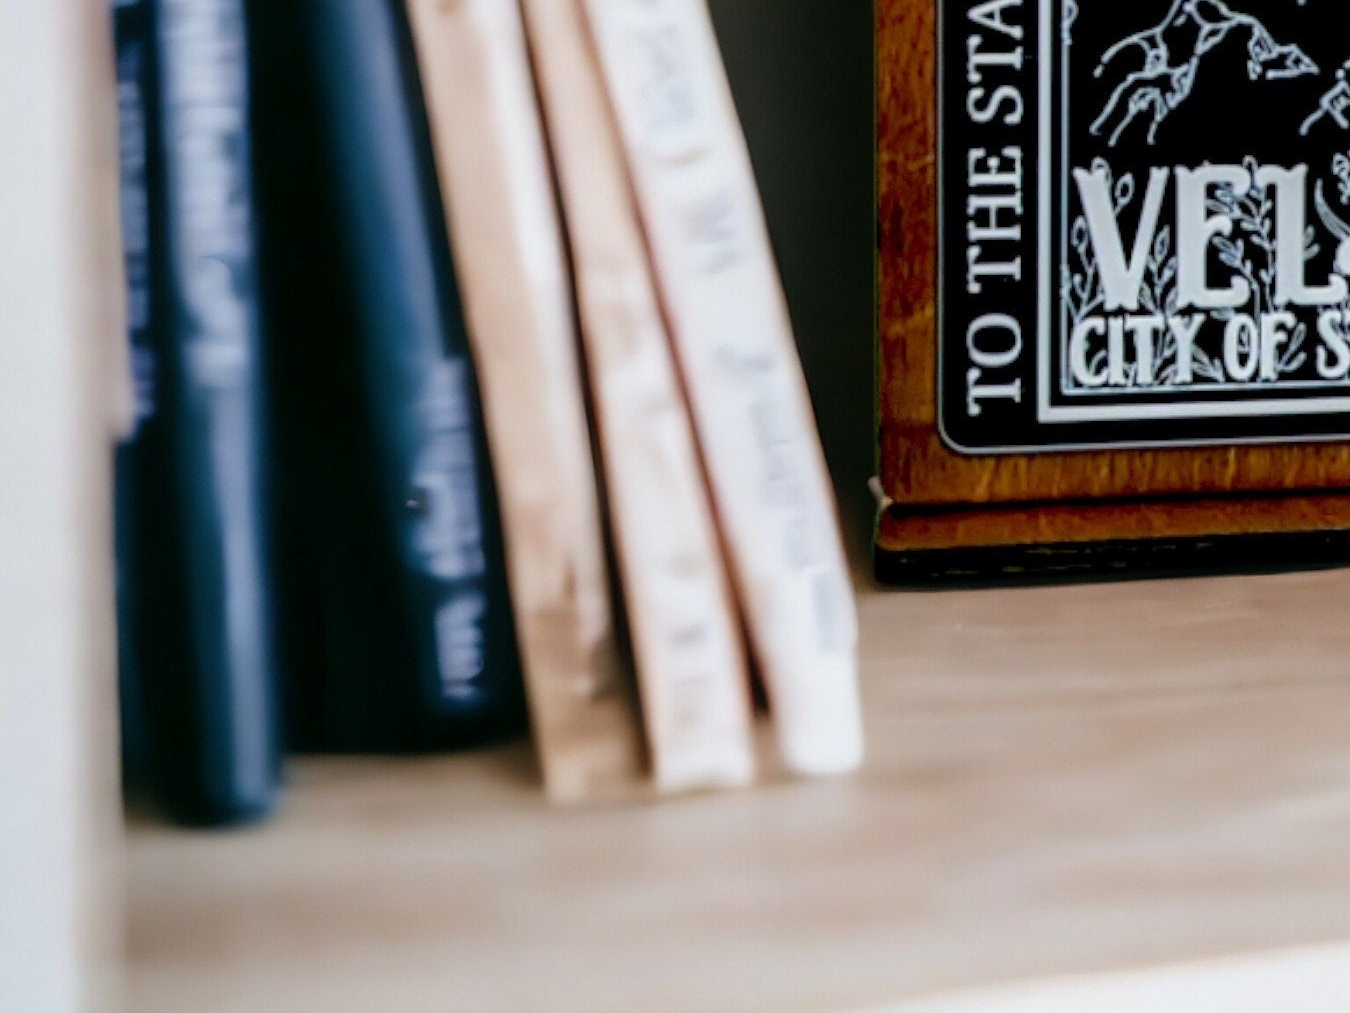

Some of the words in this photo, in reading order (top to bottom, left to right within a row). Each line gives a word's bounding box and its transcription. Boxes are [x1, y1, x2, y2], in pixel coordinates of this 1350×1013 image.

[966, 145, 1024, 294] THE
[966, 313, 1024, 417] TO
[1069, 310, 1207, 387] CITY
[1222, 310, 1296, 383] OF
